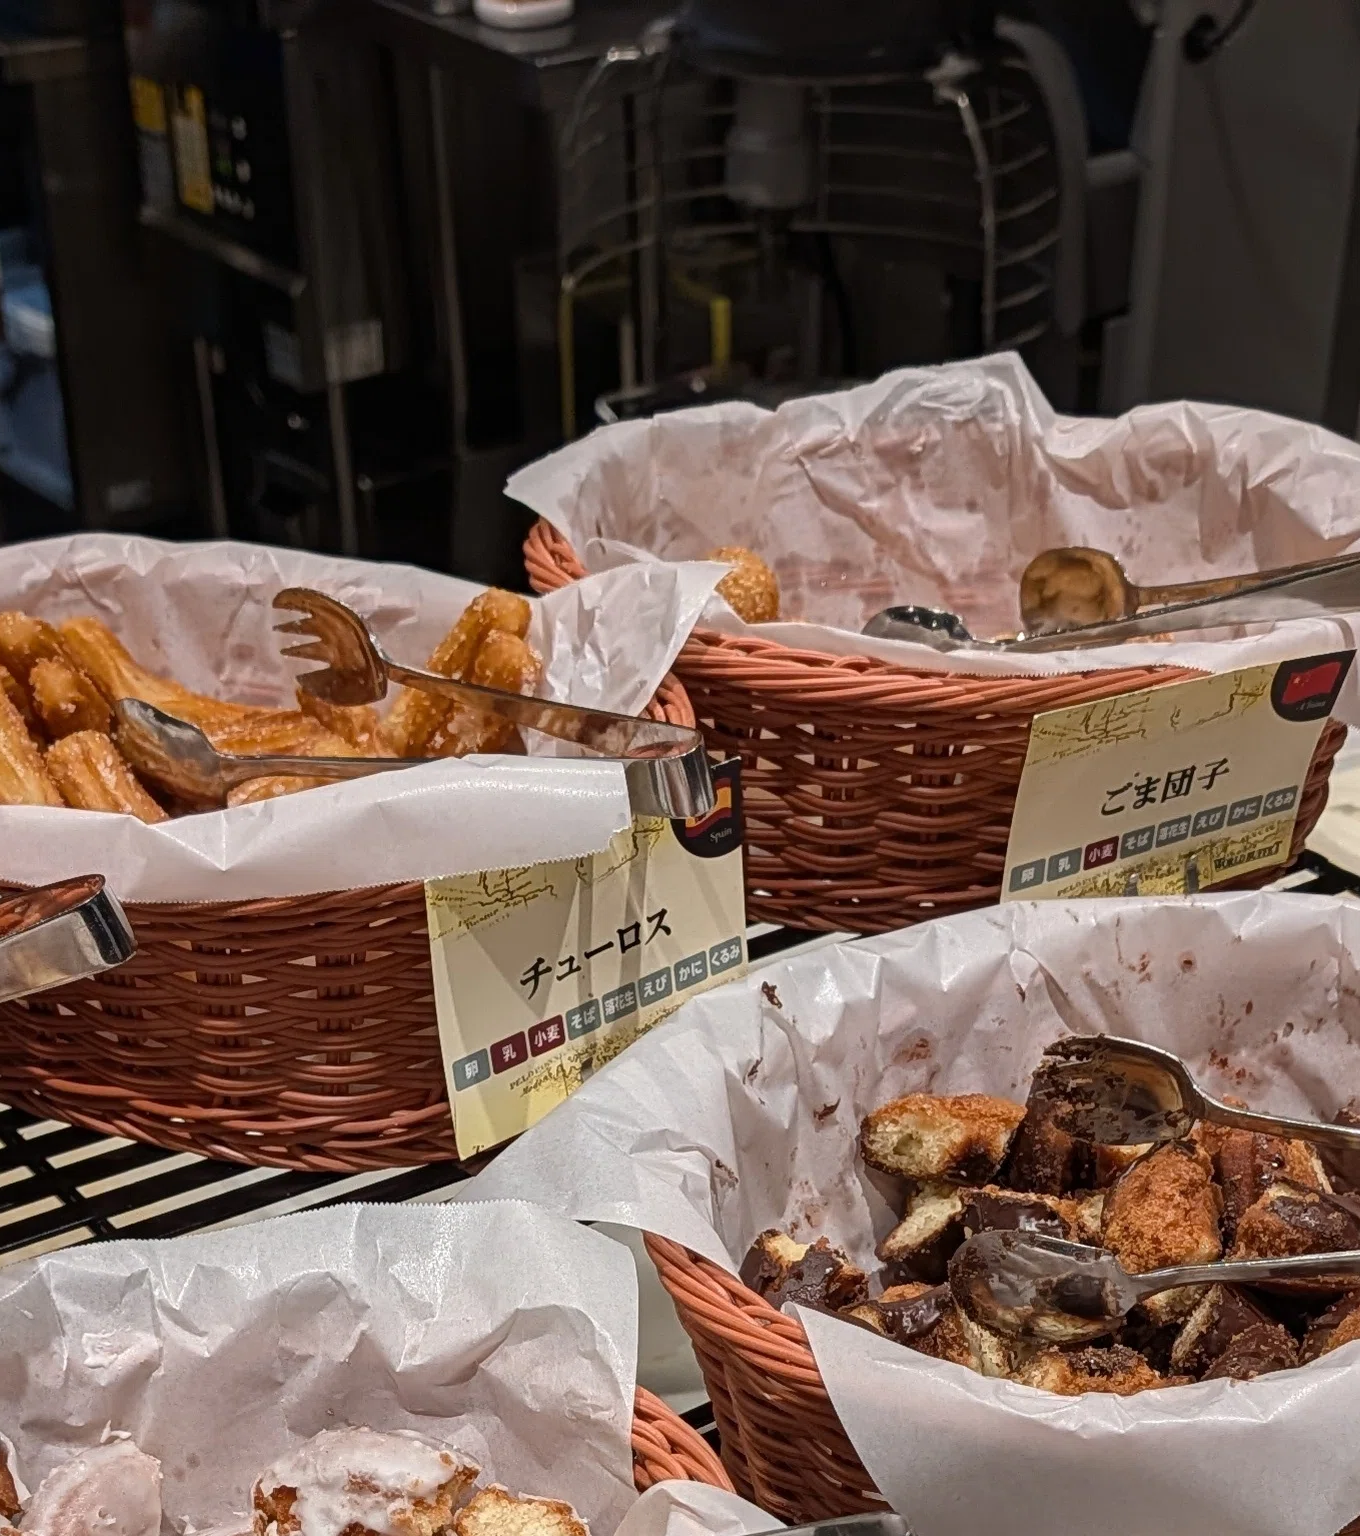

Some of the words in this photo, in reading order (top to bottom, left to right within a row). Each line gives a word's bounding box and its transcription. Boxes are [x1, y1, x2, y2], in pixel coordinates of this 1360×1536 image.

[1100, 757, 1230, 817] ごま団子
[1057, 856, 1071, 873] 乳
[1088, 844, 1114, 863] 小麦
[1125, 833, 1151, 850] そば
[1196, 812, 1221, 829] えび
[1232, 802, 1257, 820] かに
[1264, 792, 1294, 811] くるみ
[519, 908, 672, 1000] チューロス
[464, 1059, 479, 1079] 卵
[502, 1043, 517, 1062] 乳
[534, 1025, 561, 1048] 小麦
[570, 1006, 596, 1030] そば
[643, 974, 668, 997] えび
[678, 959, 703, 982] かに
[711, 943, 741, 967] くるみ
